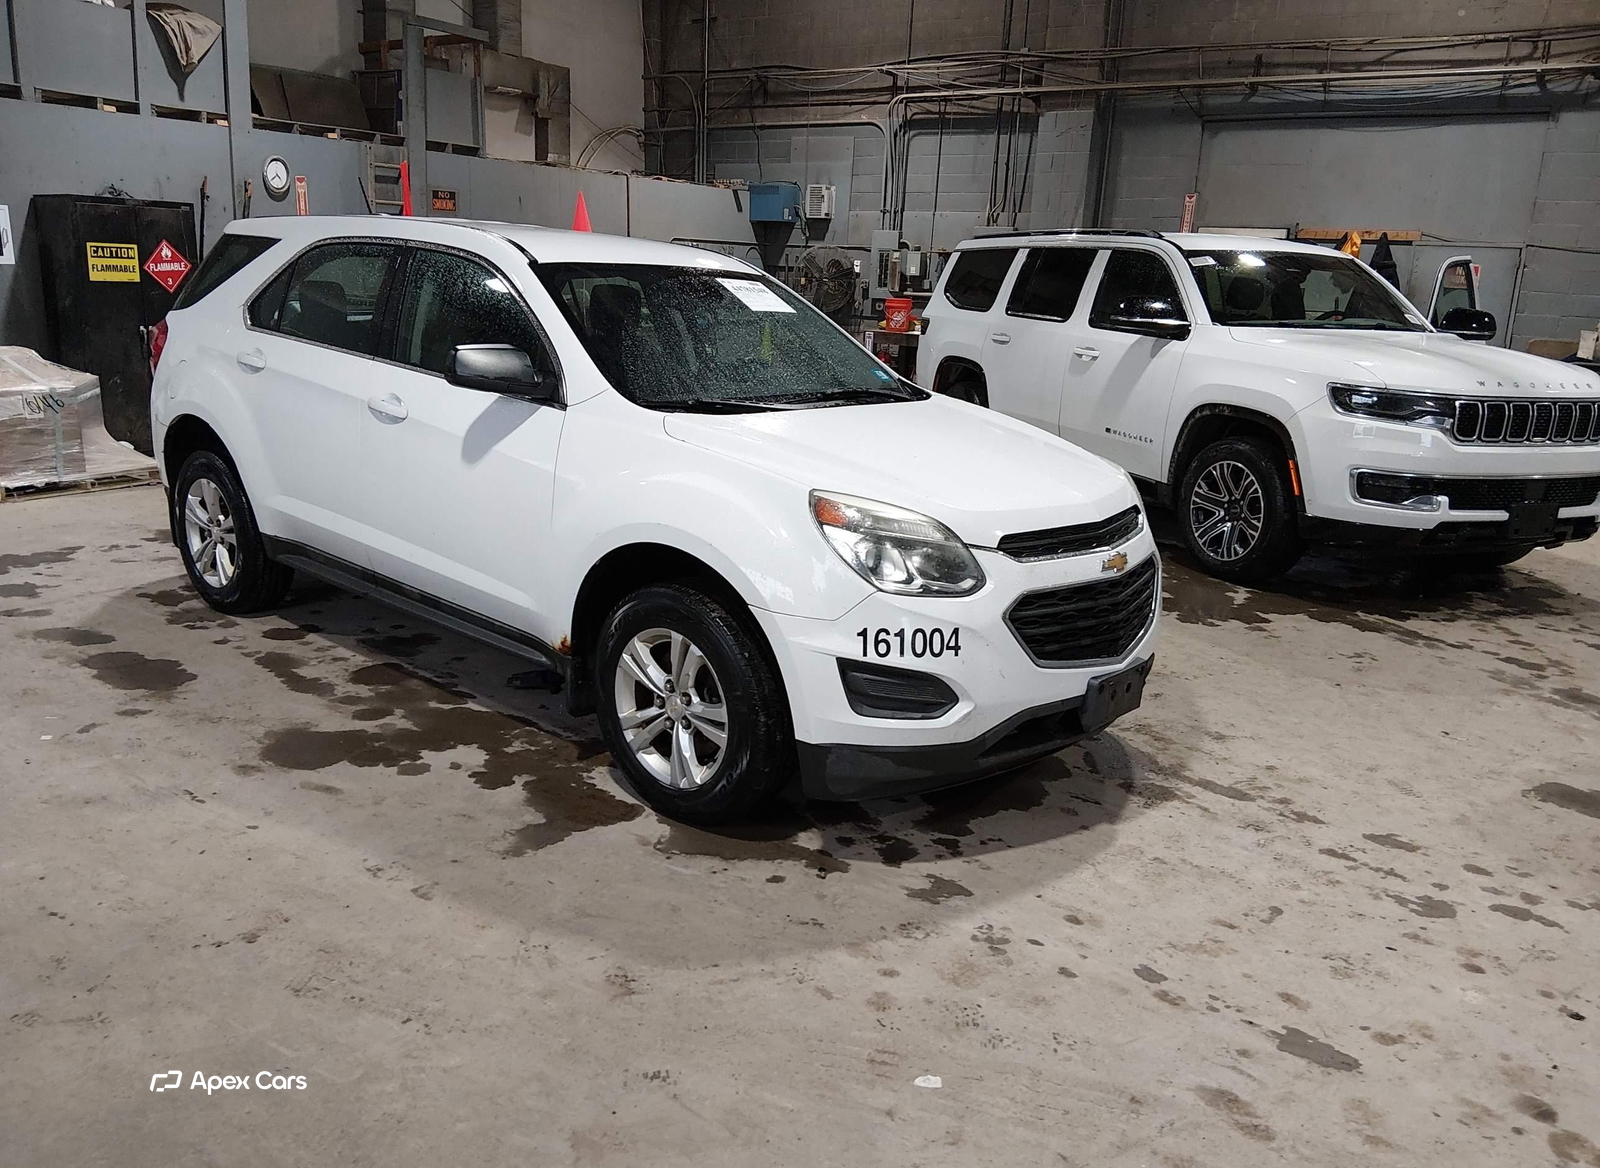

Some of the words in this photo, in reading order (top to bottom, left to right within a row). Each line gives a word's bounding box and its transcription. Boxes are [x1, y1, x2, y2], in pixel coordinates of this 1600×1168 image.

[90, 247, 134, 258] CAUTION
[92, 264, 136, 273] FLAMMABLE
[150, 262, 186, 272] FLAMMABLE
[167, 277, 172, 285] 3
[857, 628, 961, 658] 161004
